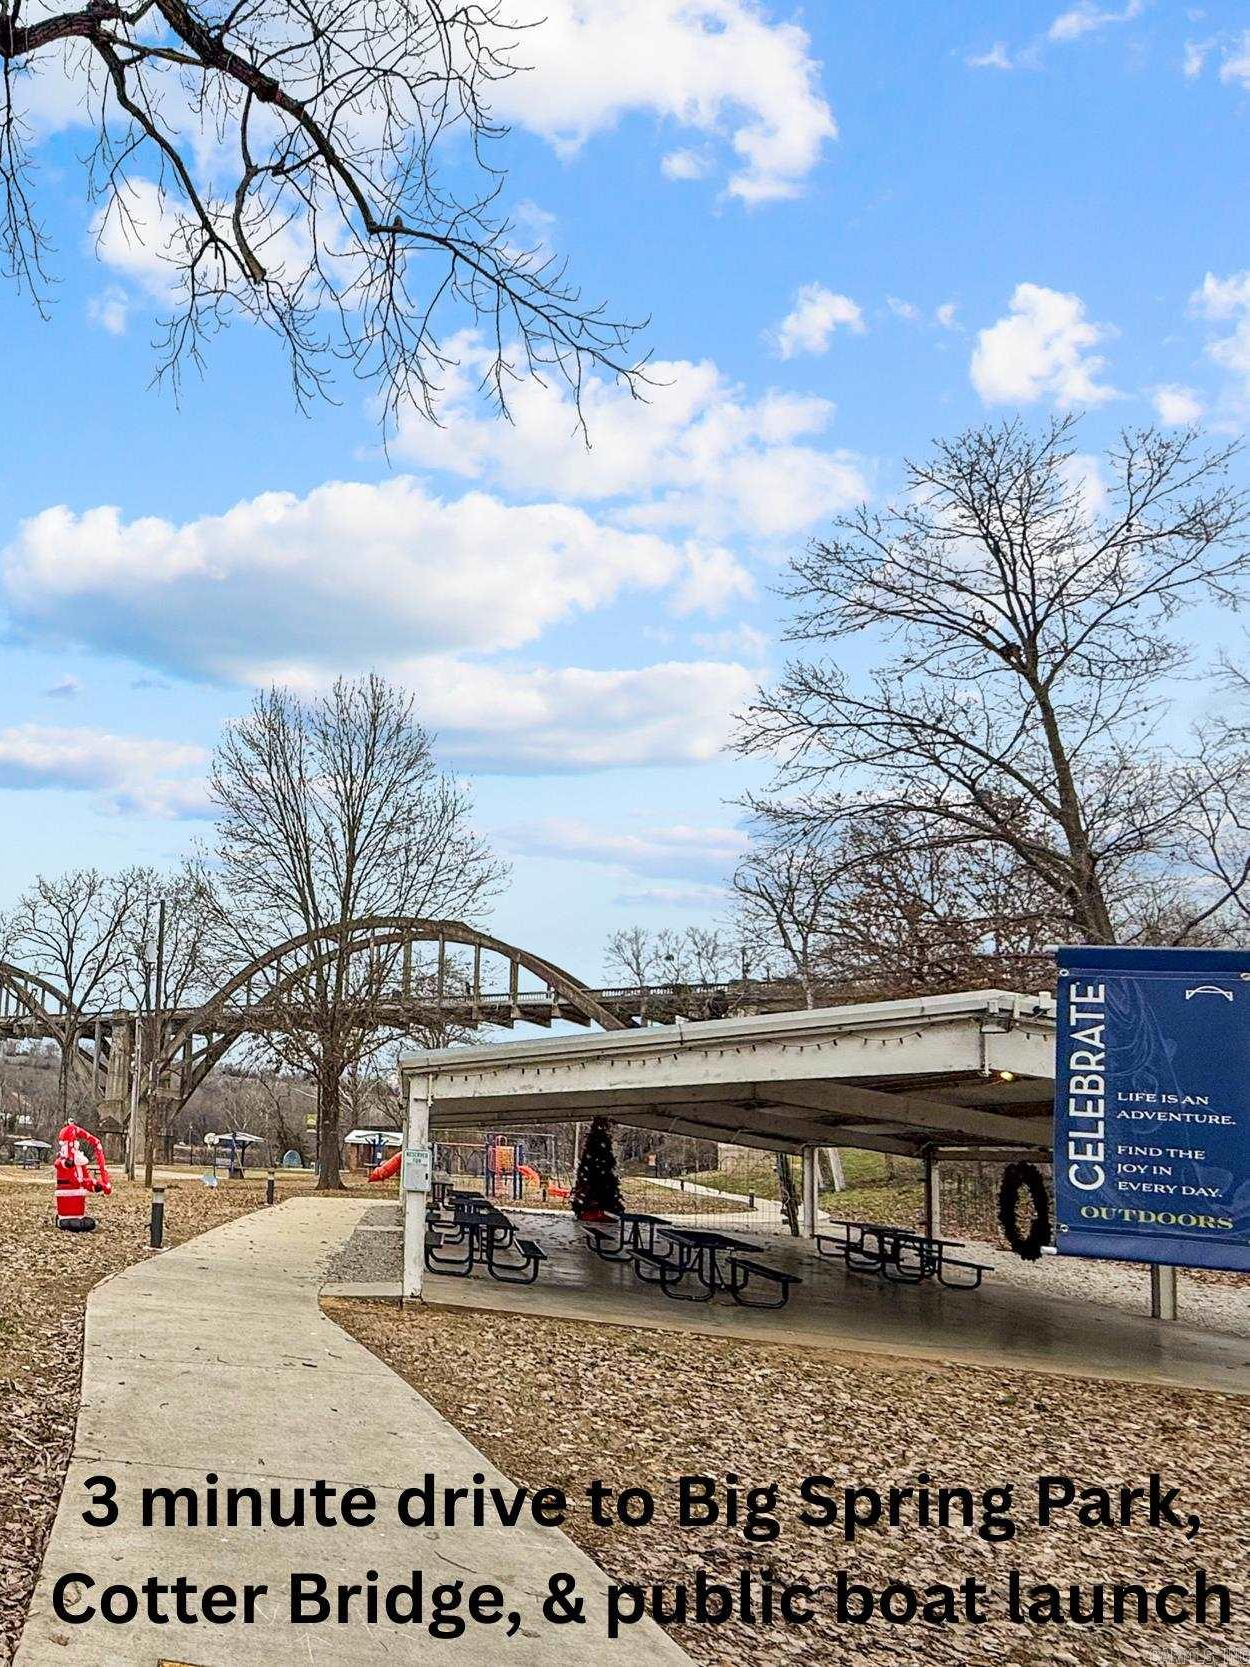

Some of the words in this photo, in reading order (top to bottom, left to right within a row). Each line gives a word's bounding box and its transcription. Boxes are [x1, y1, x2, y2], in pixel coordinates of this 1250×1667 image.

[1068, 983, 1105, 1191] CELEBRATE
[1117, 1092, 1156, 1103] LIFE
[1161, 1094, 1178, 1104] IS
[1181, 1096, 1209, 1106] AN
[1116, 1110, 1237, 1125] ADVENTURE.
[1117, 1145, 1163, 1157] FIND
[1166, 1148, 1206, 1160] THE
[1116, 1163, 1149, 1175] JOY
[1152, 1166, 1173, 1176] IN
[1118, 1181, 1178, 1195] EVERY
[1181, 1186, 1223, 1198] DAY.
[1080, 1204, 1234, 1230] OUTDOORS
